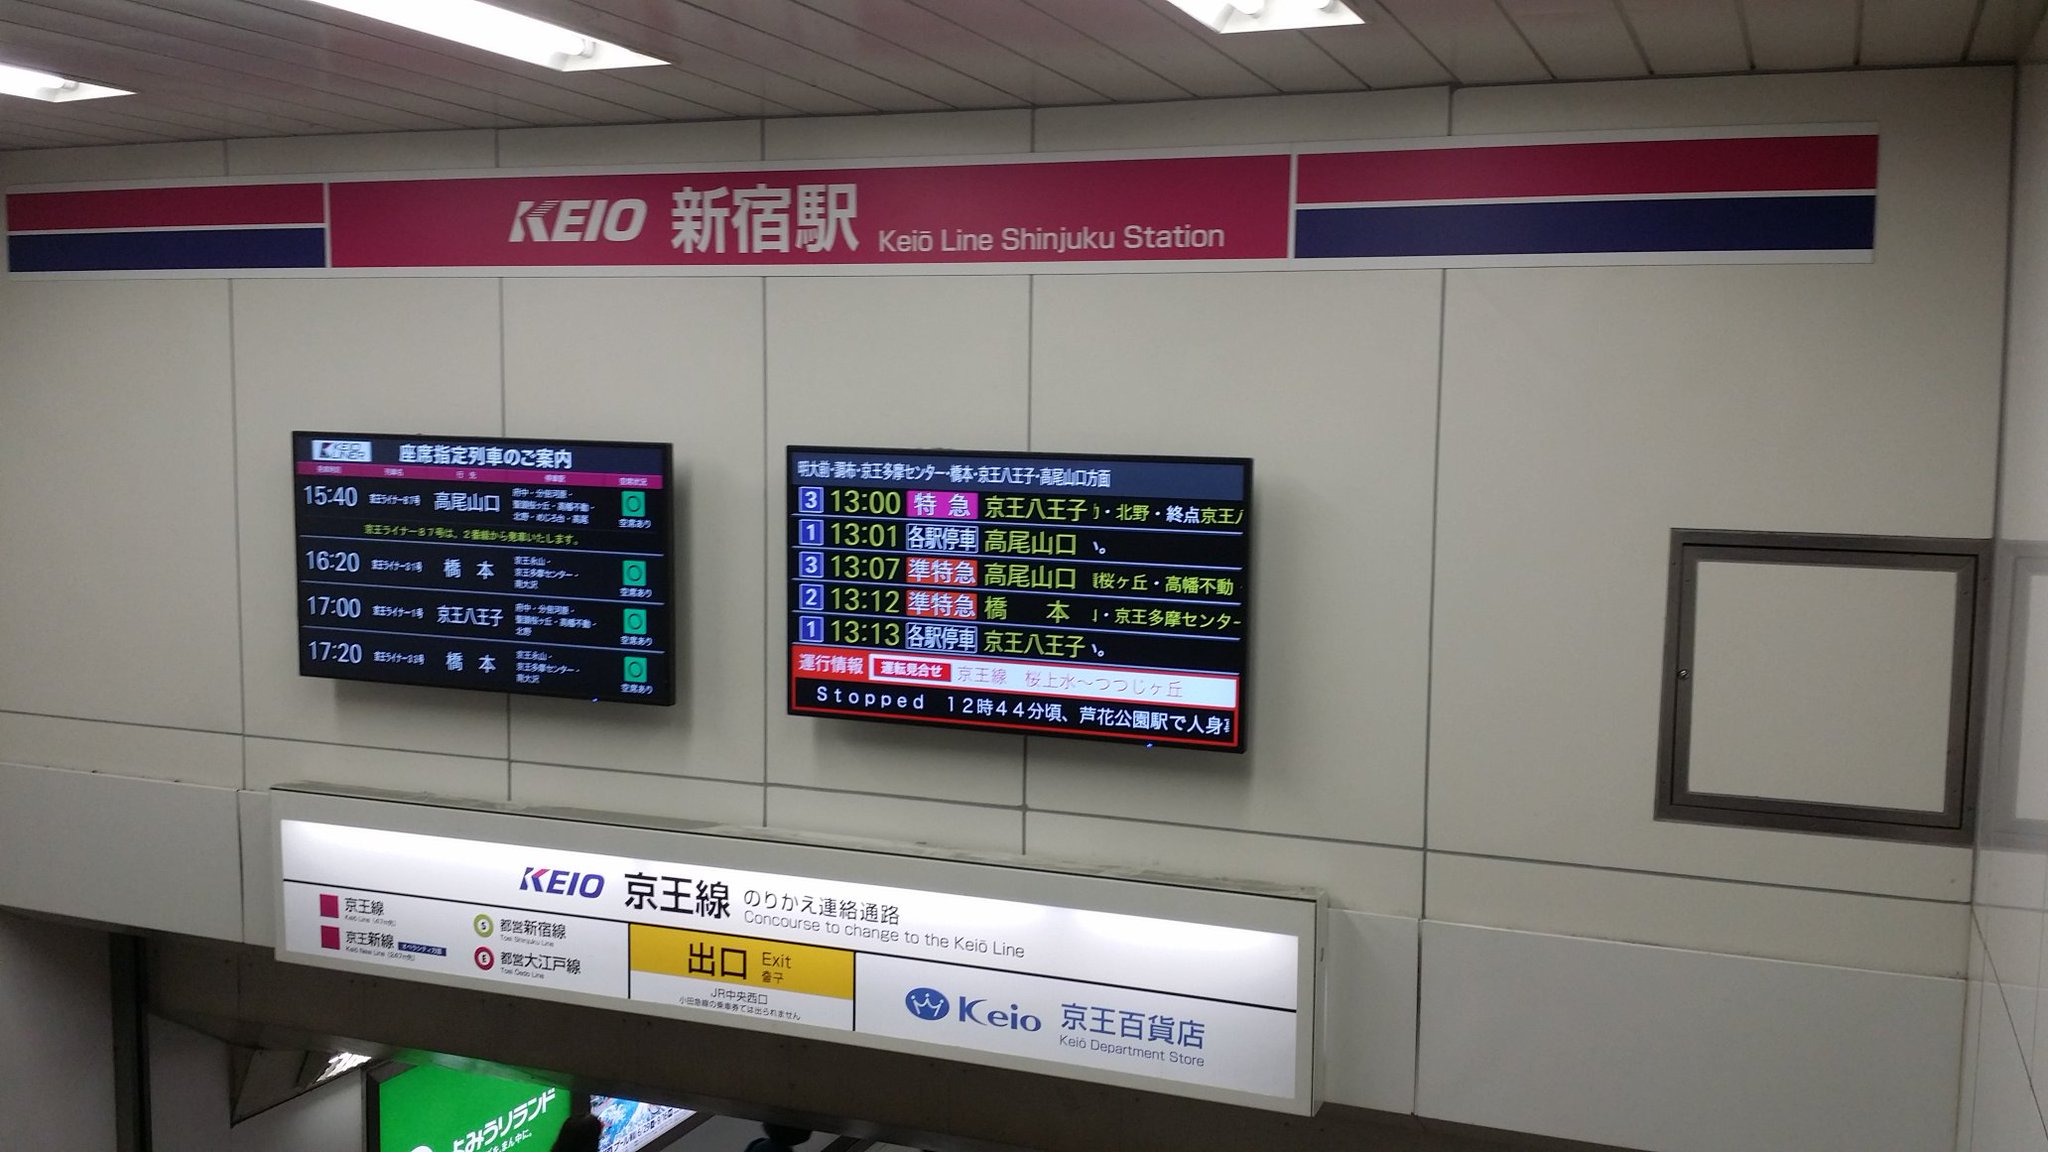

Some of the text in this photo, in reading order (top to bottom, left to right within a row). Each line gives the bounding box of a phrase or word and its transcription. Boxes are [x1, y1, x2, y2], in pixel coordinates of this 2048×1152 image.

[508, 199, 648, 242] KEIO
[671, 183, 859, 254] 新宿駅
[879, 223, 1225, 253] Keiō Line Shinjuku Station
[399, 444, 573, 469] 座席指定列車のご案内
[304, 485, 358, 507] 15:40
[433, 491, 500, 513] 高尾山口
[804, 491, 818, 509] 3
[831, 489, 901, 515] 13:00
[985, 495, 1087, 522] 京王八王子
[806, 523, 816, 541] 1
[831, 522, 897, 547] 13:01
[908, 525, 977, 551] 各駅停車
[984, 528, 1077, 555] 高尾山口
[306, 550, 360, 573] 16:20
[804, 556, 818, 574] 3
[831, 554, 900, 580] 13:07
[908, 558, 976, 585] 準特急
[984, 562, 1076, 589] 高尾山口
[307, 596, 361, 618] 17:00
[436, 604, 503, 627] 京王八王子
[804, 588, 818, 606] 2
[831, 587, 900, 613] 13:12
[908, 591, 976, 617] 準特急
[308, 641, 362, 664] 17:20
[806, 621, 816, 638] 1
[831, 620, 900, 646] 13:13
[907, 624, 976, 650] 各駅停車
[984, 630, 1086, 658] 京王八王子
[799, 653, 864, 675] 運行情報
[881, 660, 943, 678] 運転見合せ
[957, 665, 1007, 685] 京王線
[816, 685, 925, 710] Stopped
[519, 867, 605, 899] KEIO
[345, 897, 384, 916] 京王線
[624, 871, 900, 925] 京王線 のりかえ連絡通路
[481, 921, 487, 930] S
[500, 918, 567, 940] 都営新宿線
[744, 910, 1025, 959] Concourse to change to the Keiō Line
[346, 931, 394, 949] 京王新線
[481, 954, 487, 963] E
[500, 951, 582, 975] 都営大江戸線
[688, 942, 747, 980] 出口
[762, 952, 792, 969] Exit
[711, 988, 768, 1005] JR中央西口
[958, 996, 1042, 1032] Keio
[1061, 1002, 1206, 1050] 京王百貨店
[1090, 1038, 1165, 1062] Department
[1169, 1051, 1205, 1068] Store
